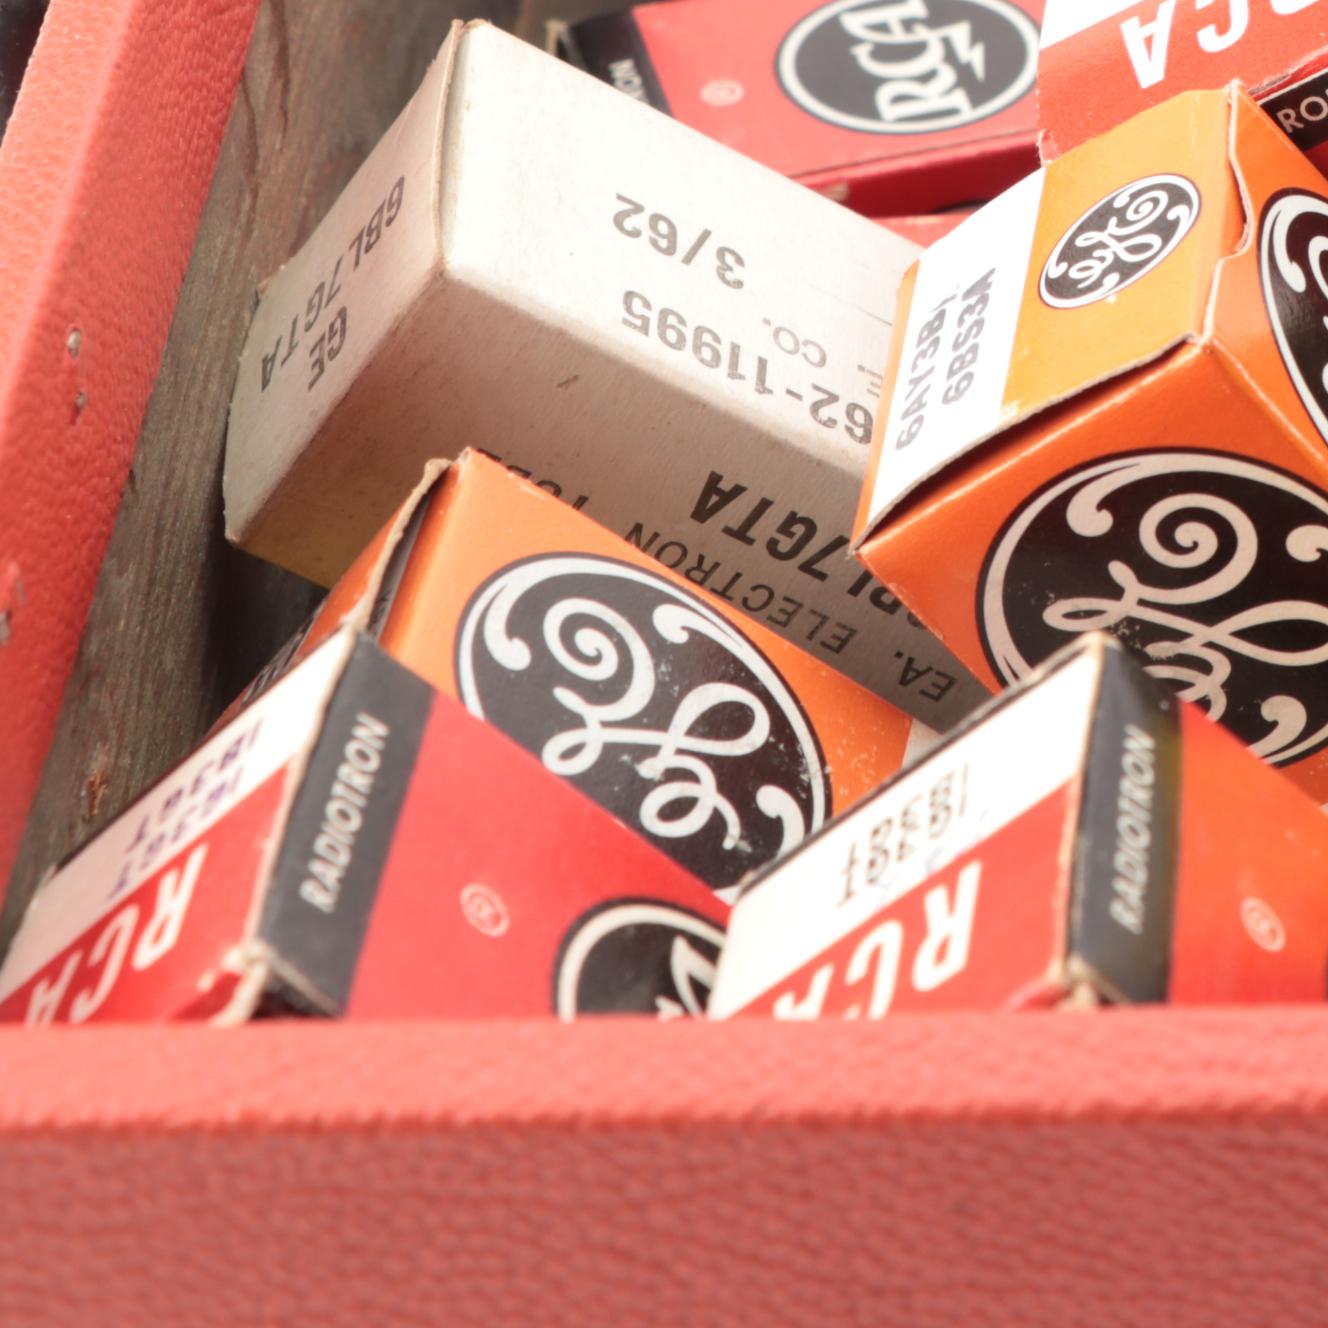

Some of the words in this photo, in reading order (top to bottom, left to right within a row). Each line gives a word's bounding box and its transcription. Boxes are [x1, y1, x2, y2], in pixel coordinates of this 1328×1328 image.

[612, 193, 747, 291] 3/62
[307, 305, 348, 393] GE
[624, 521, 860, 655] ELECTRON
[300, 712, 391, 915] RADIOTRON
[1110, 725, 1158, 937] RADIOTRON
